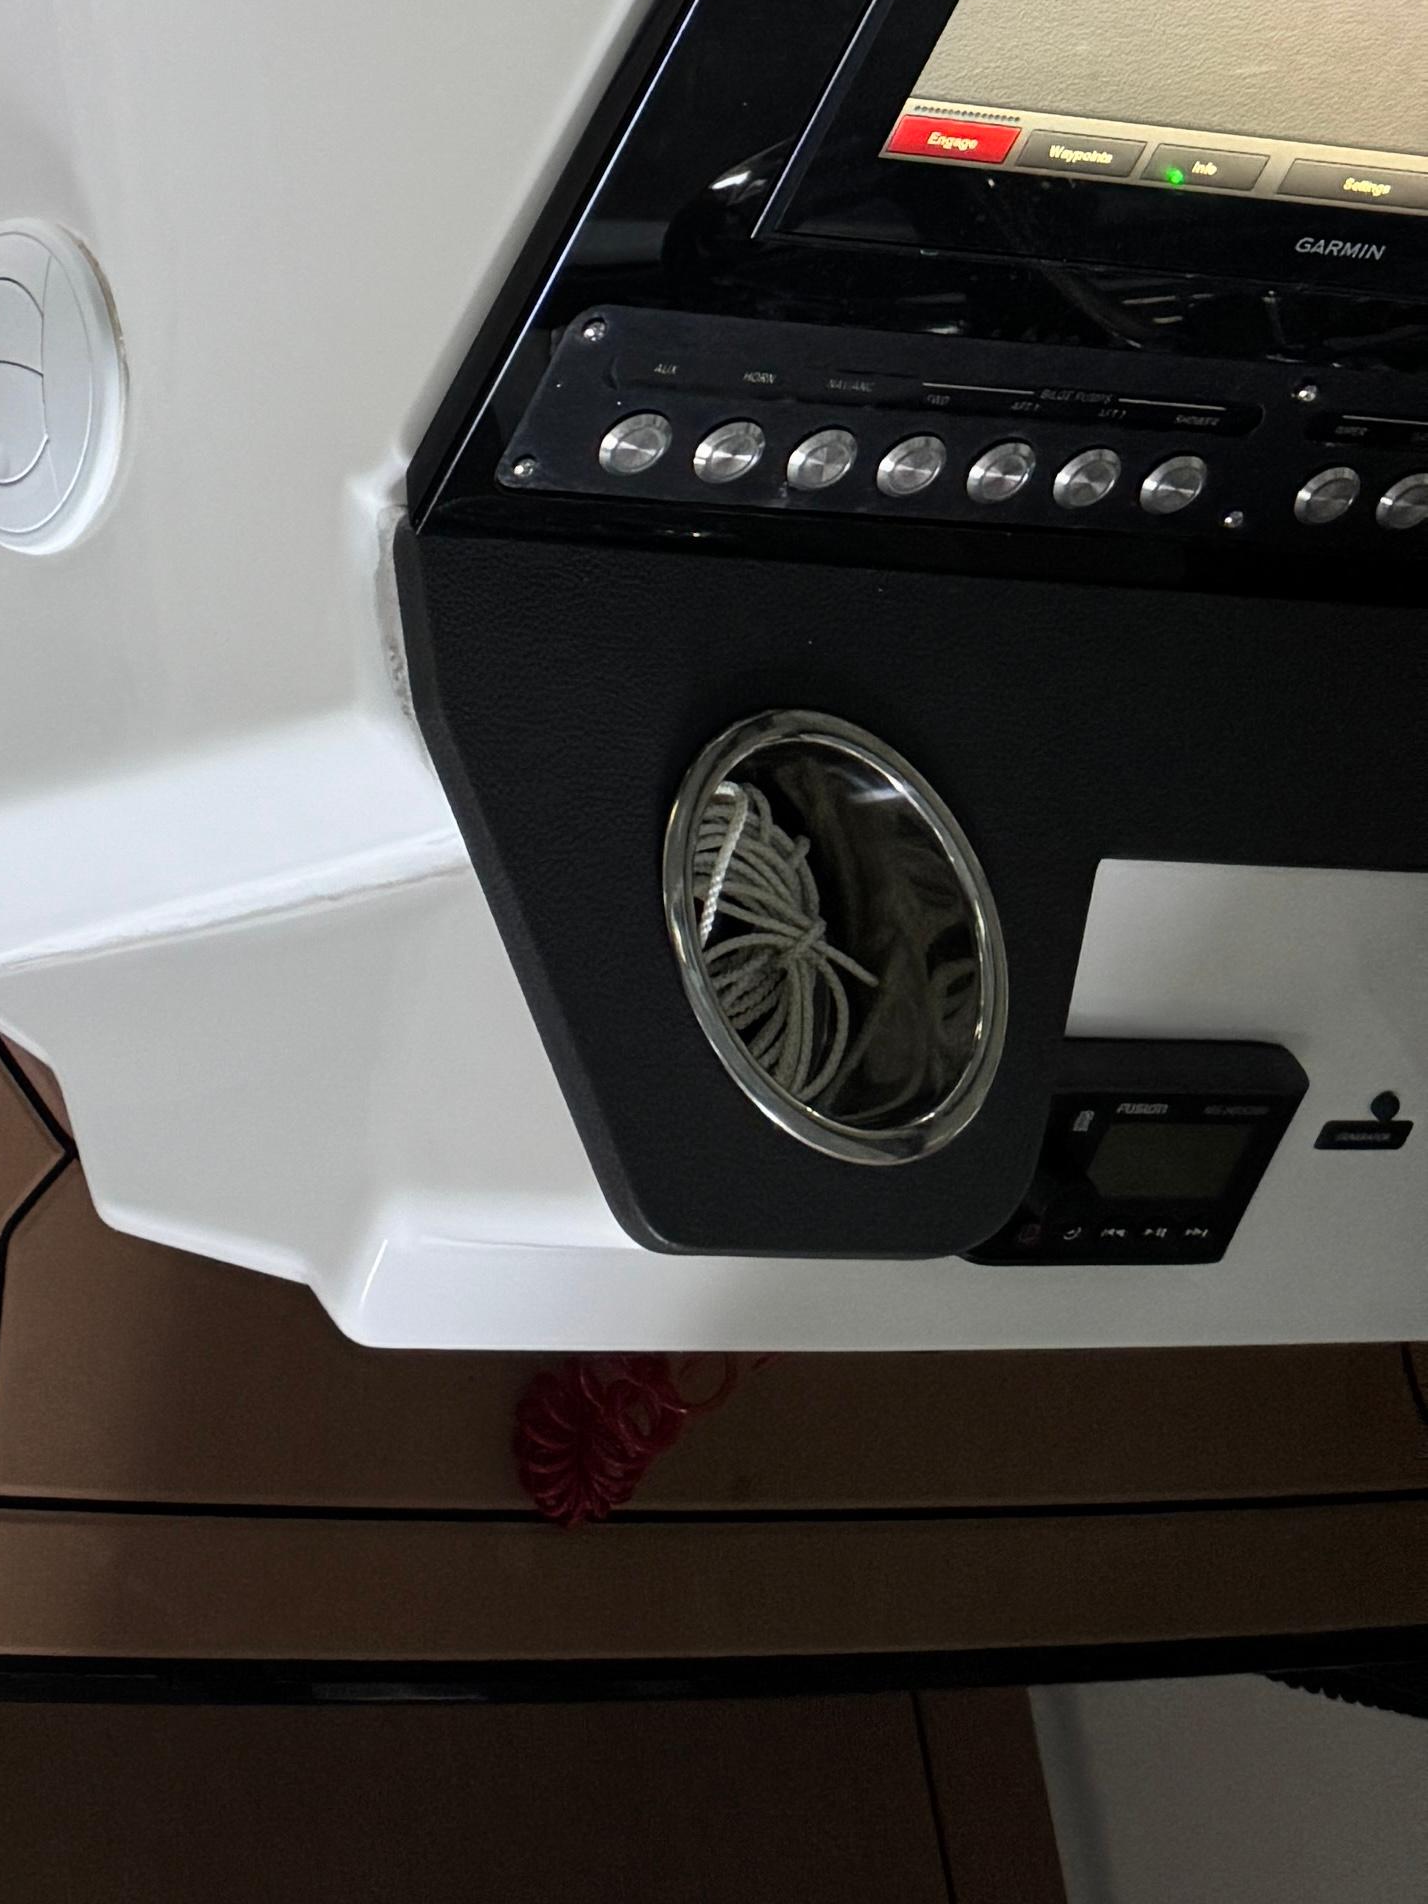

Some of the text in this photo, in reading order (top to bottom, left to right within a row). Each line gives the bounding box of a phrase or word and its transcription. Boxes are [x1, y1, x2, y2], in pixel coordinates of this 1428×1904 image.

[927, 131, 978, 151] Engage
[1049, 144, 1113, 164] Waypoints
[1192, 160, 1218, 176] Info
[1343, 177, 1391, 197] Settings
[1295, 237, 1386, 260] GARMIN
[654, 363, 678, 375] AUX
[743, 372, 776, 384] HORN
